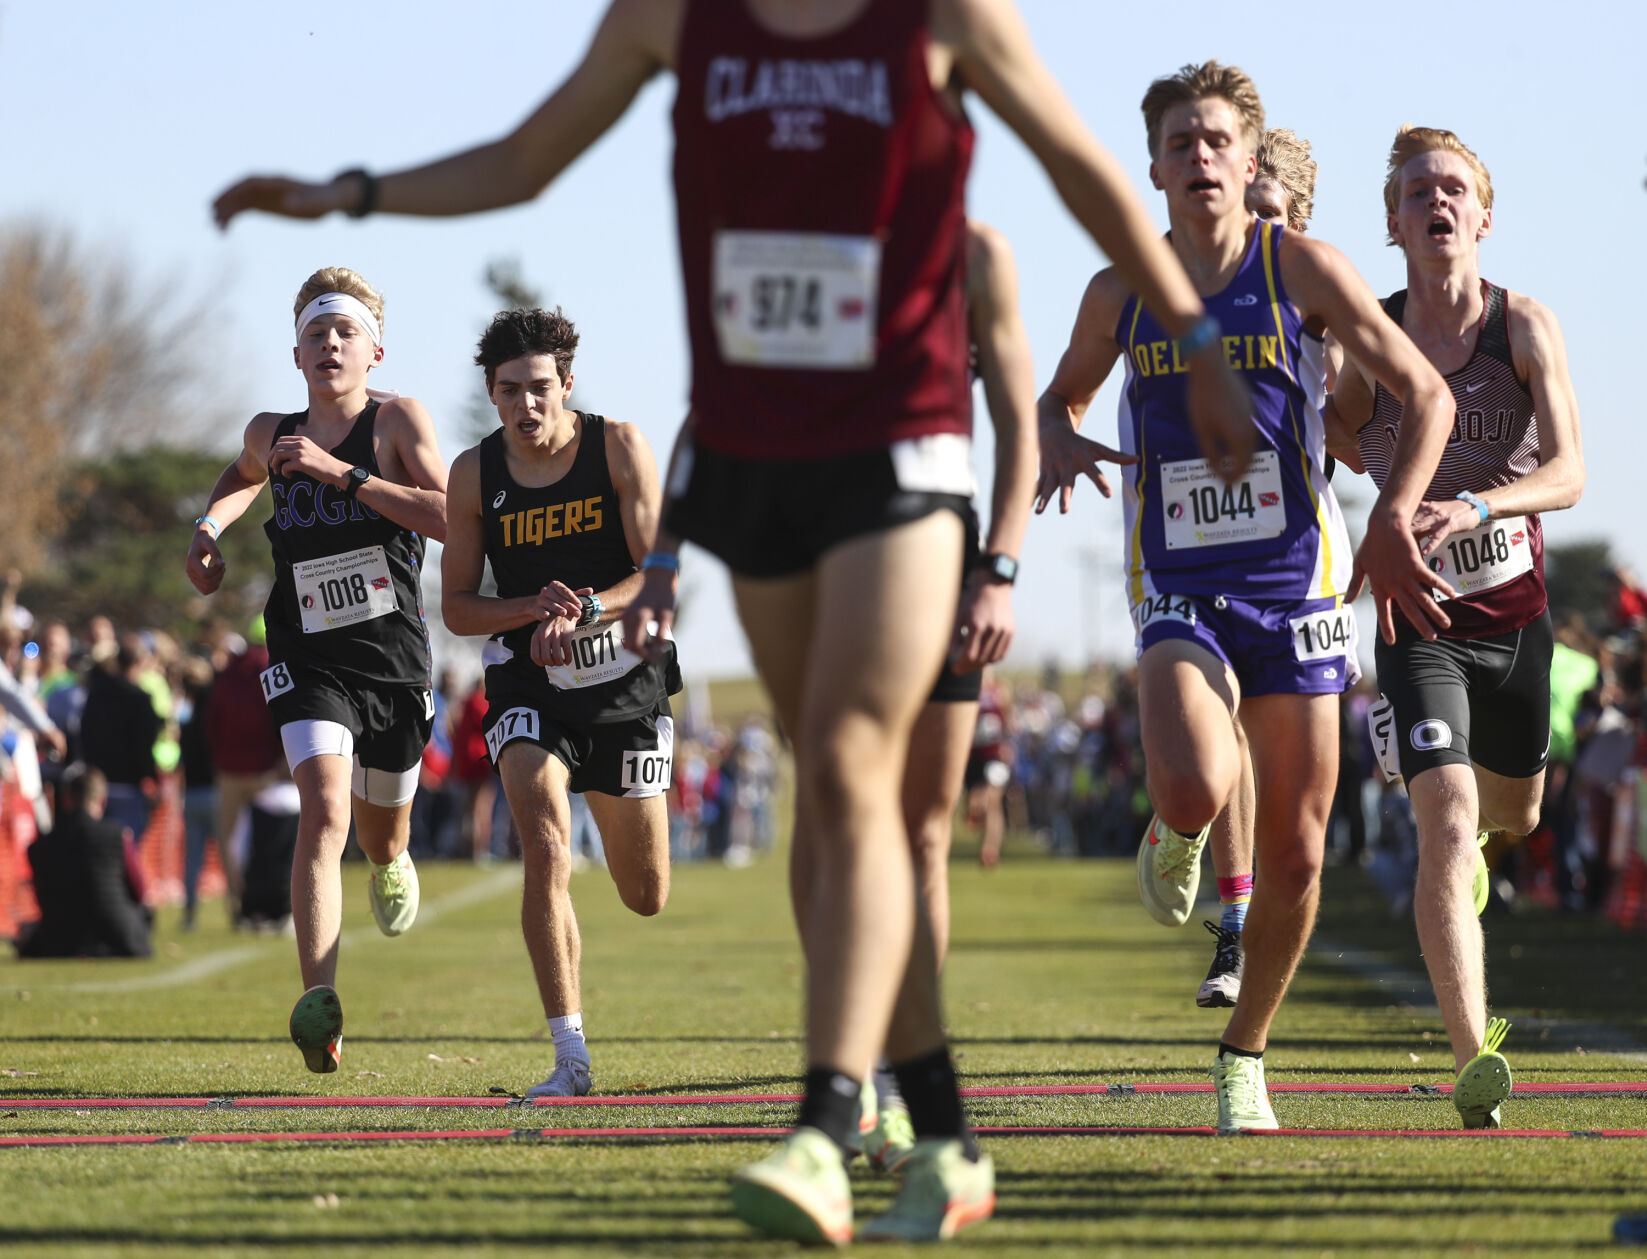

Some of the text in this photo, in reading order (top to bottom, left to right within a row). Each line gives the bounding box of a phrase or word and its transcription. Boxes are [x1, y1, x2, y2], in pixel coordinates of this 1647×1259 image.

[753, 275, 821, 331] 974
[1135, 335, 1278, 377] OELEIN
[500, 496, 602, 547] TIGERS
[1188, 482, 1256, 525] 1044
[315, 568, 336, 577] Country
[336, 557, 379, 572] Championships
[326, 559, 338, 567] High
[338, 554, 358, 564] School
[359, 551, 374, 559] State
[1448, 528, 1509, 576] 1048
[318, 573, 369, 612] 1018
[1135, 593, 1192, 625] 044
[571, 630, 617, 670] 1071
[489, 711, 533, 747] 1071
[626, 756, 671, 784] 1071
